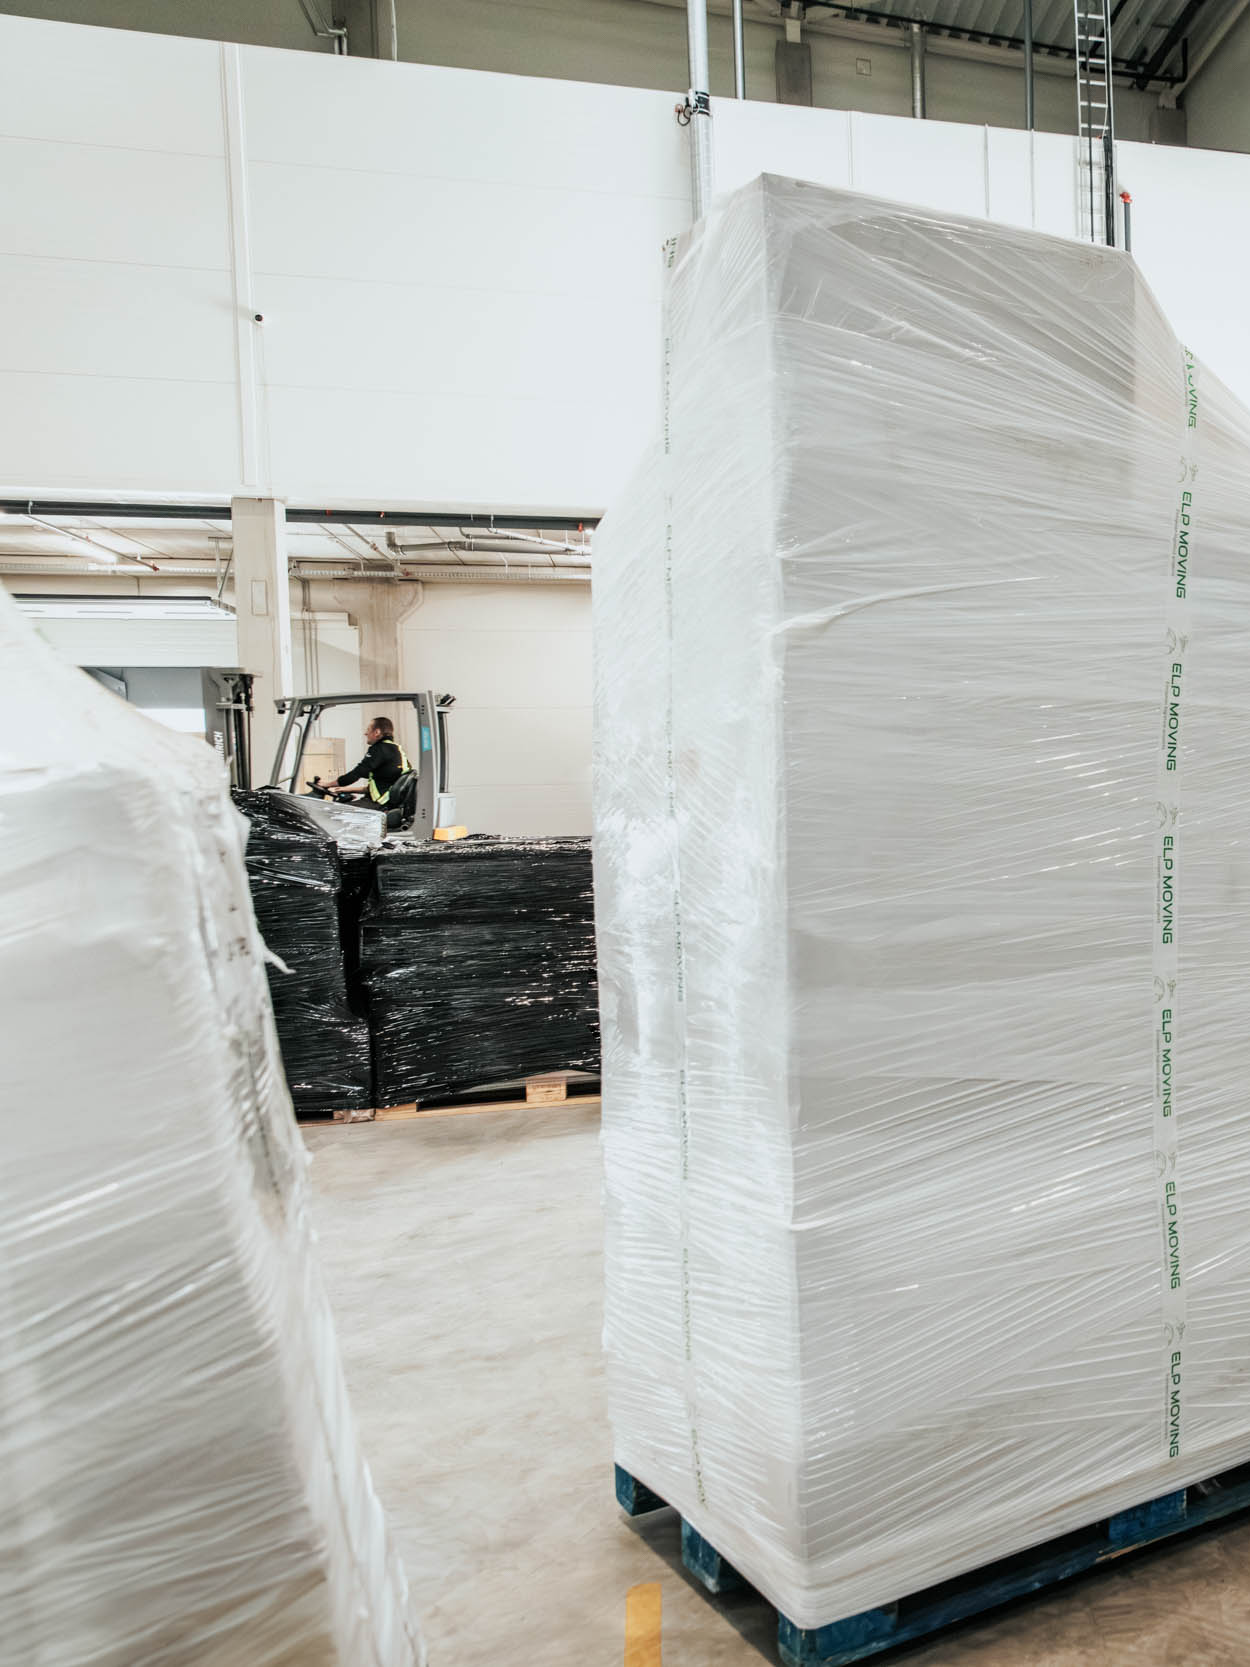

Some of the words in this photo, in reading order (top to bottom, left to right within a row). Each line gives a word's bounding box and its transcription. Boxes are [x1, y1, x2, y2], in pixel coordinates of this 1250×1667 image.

[1181, 491, 1193, 526] ELP
[1176, 531, 1190, 599] MOVING
[1171, 663, 1183, 697] ELP
[1166, 702, 1180, 771] MOVING
[1163, 836, 1174, 870] ELP
[1162, 876, 1174, 944] MOVING
[1161, 1008, 1172, 1043] ELP
[1162, 1049, 1172, 1117] MOVING
[1165, 1181, 1177, 1216] ELP
[1168, 1221, 1180, 1289] MOVING
[1170, 1351, 1181, 1386] ELP
[1169, 1390, 1181, 1458] MOVING
